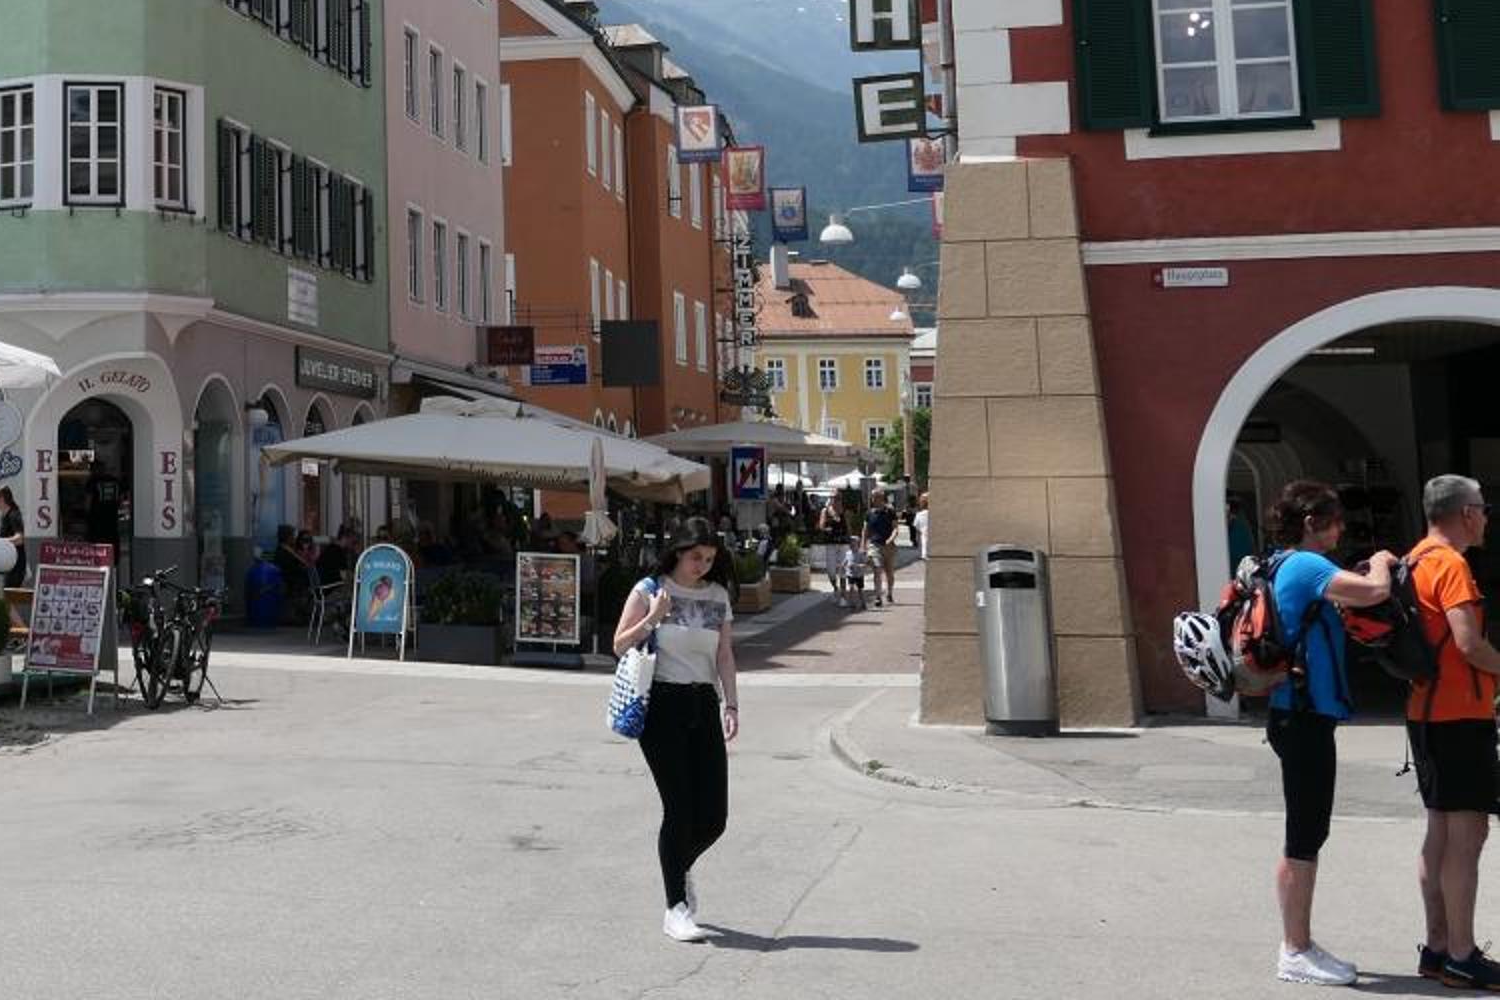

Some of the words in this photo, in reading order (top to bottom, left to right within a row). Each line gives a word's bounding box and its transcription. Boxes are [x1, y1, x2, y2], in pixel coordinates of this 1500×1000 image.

[100, 370, 151, 394] GELATO
[35, 449, 53, 528] EIS
[160, 450, 178, 530] EIS
